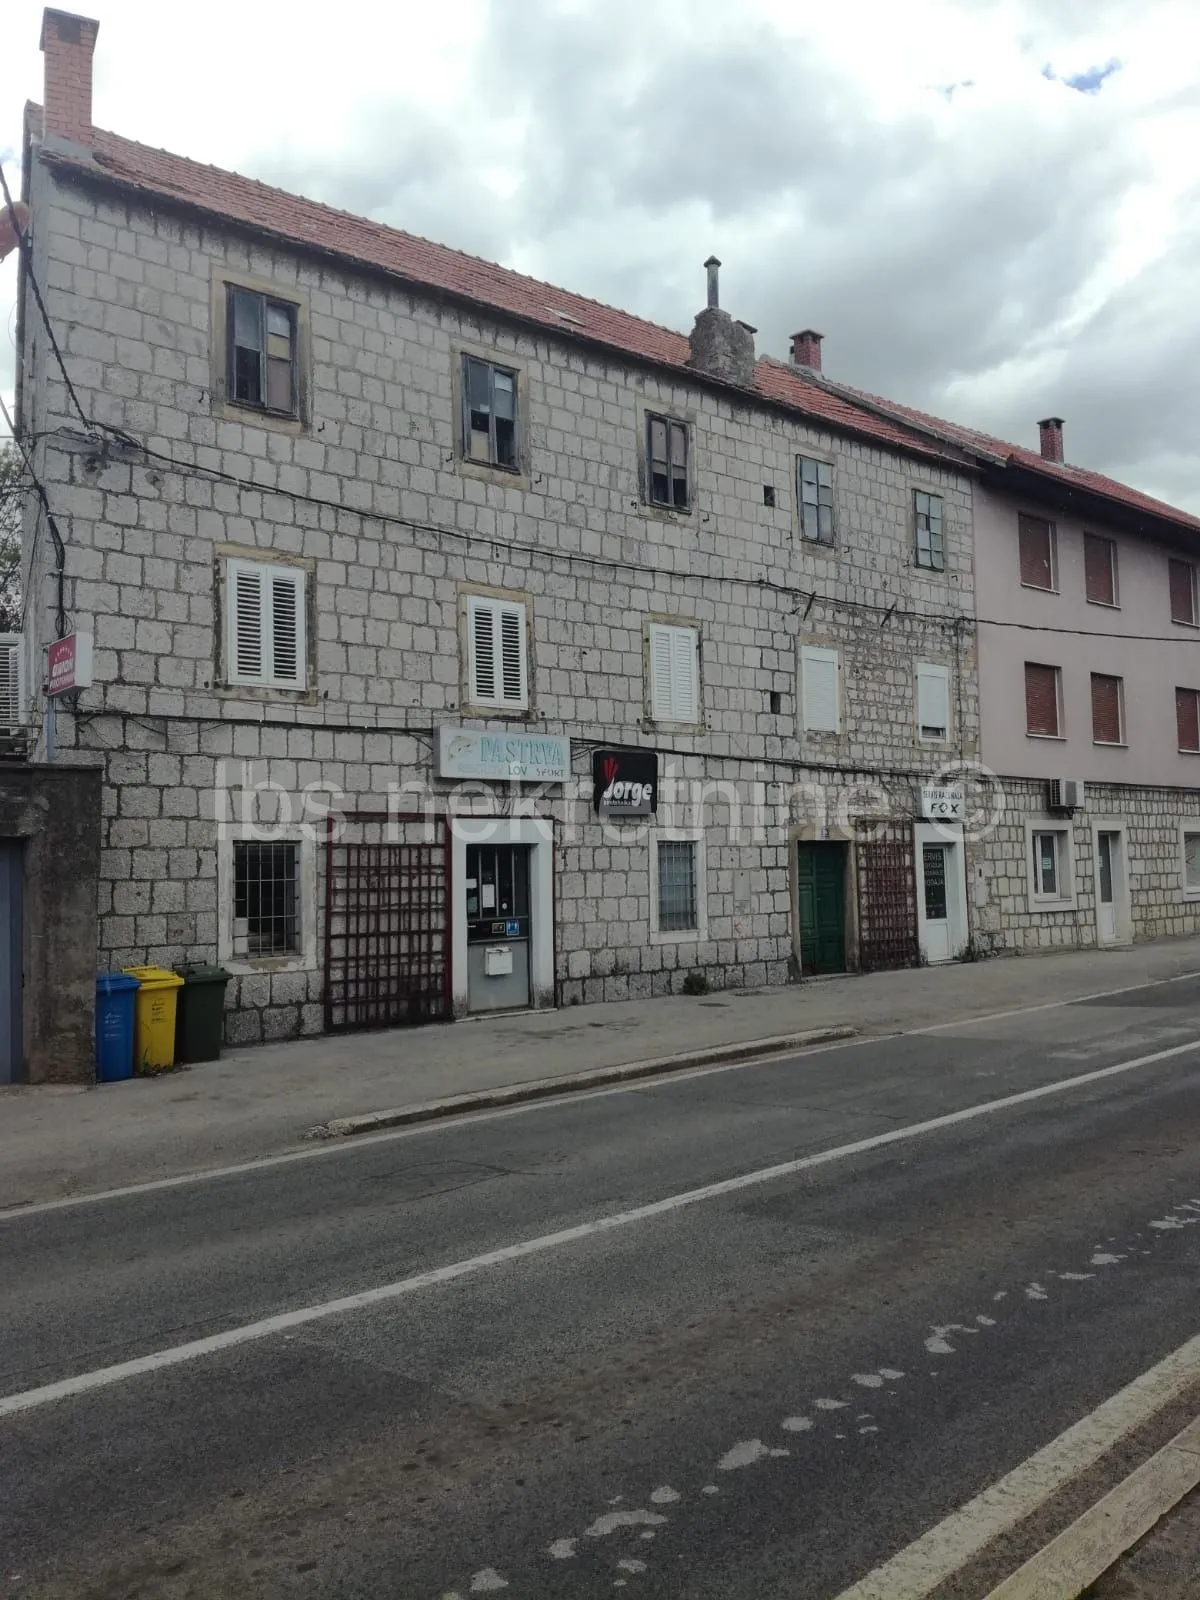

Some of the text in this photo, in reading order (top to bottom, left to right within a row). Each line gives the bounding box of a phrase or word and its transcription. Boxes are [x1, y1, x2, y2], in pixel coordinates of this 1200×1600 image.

[480, 736, 565, 765] PASTRVA
[508, 766, 527, 776] LOV
[603, 777, 653, 807] Jorge
[930, 802, 960, 814] FOX
